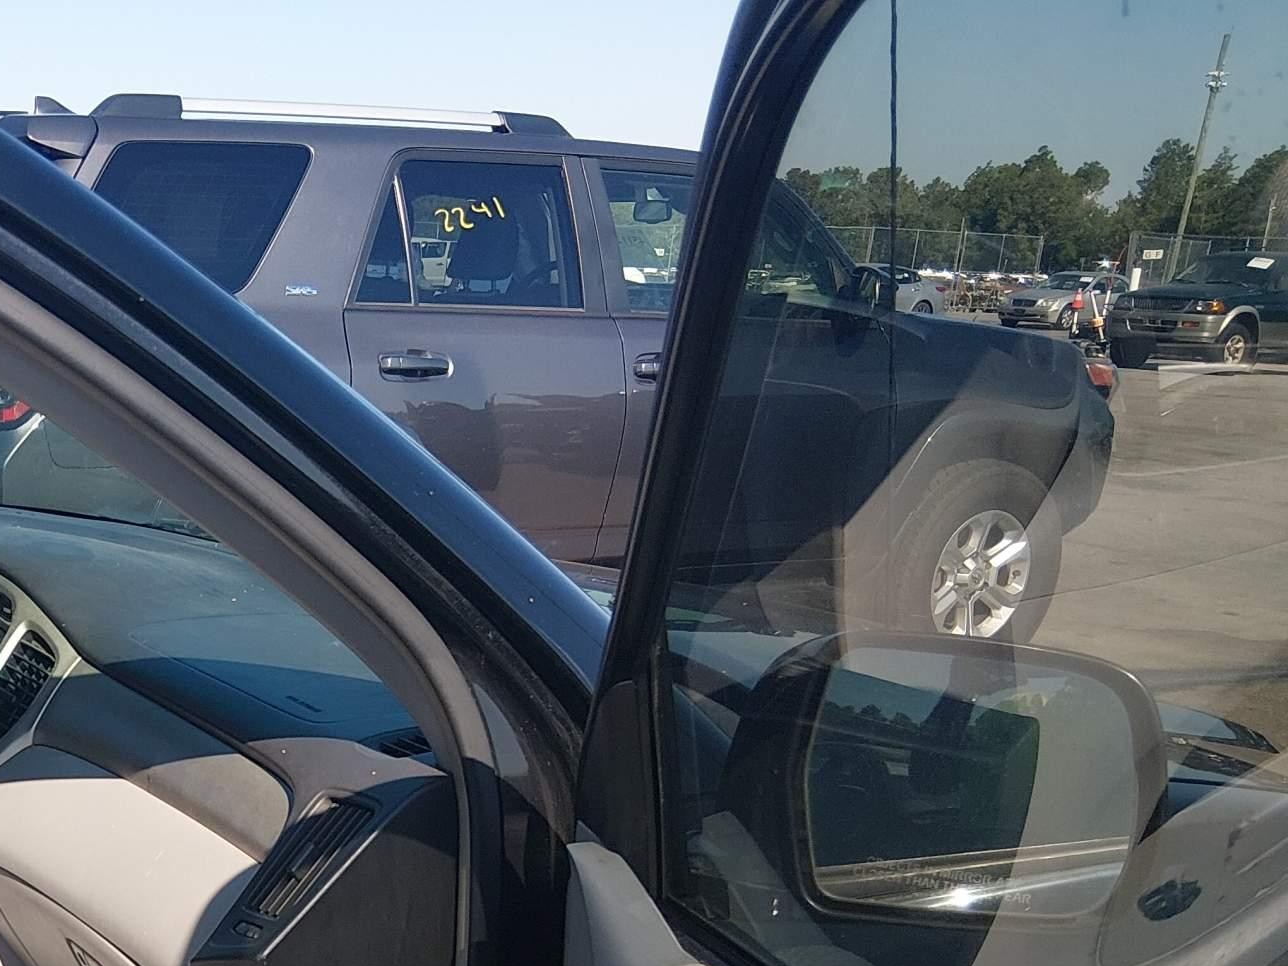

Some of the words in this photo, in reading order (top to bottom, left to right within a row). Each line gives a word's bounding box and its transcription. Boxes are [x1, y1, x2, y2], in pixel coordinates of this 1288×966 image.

[434, 196, 505, 232] 2241
[905, 877, 940, 889] THAN
[939, 869, 993, 885] MIRROR
